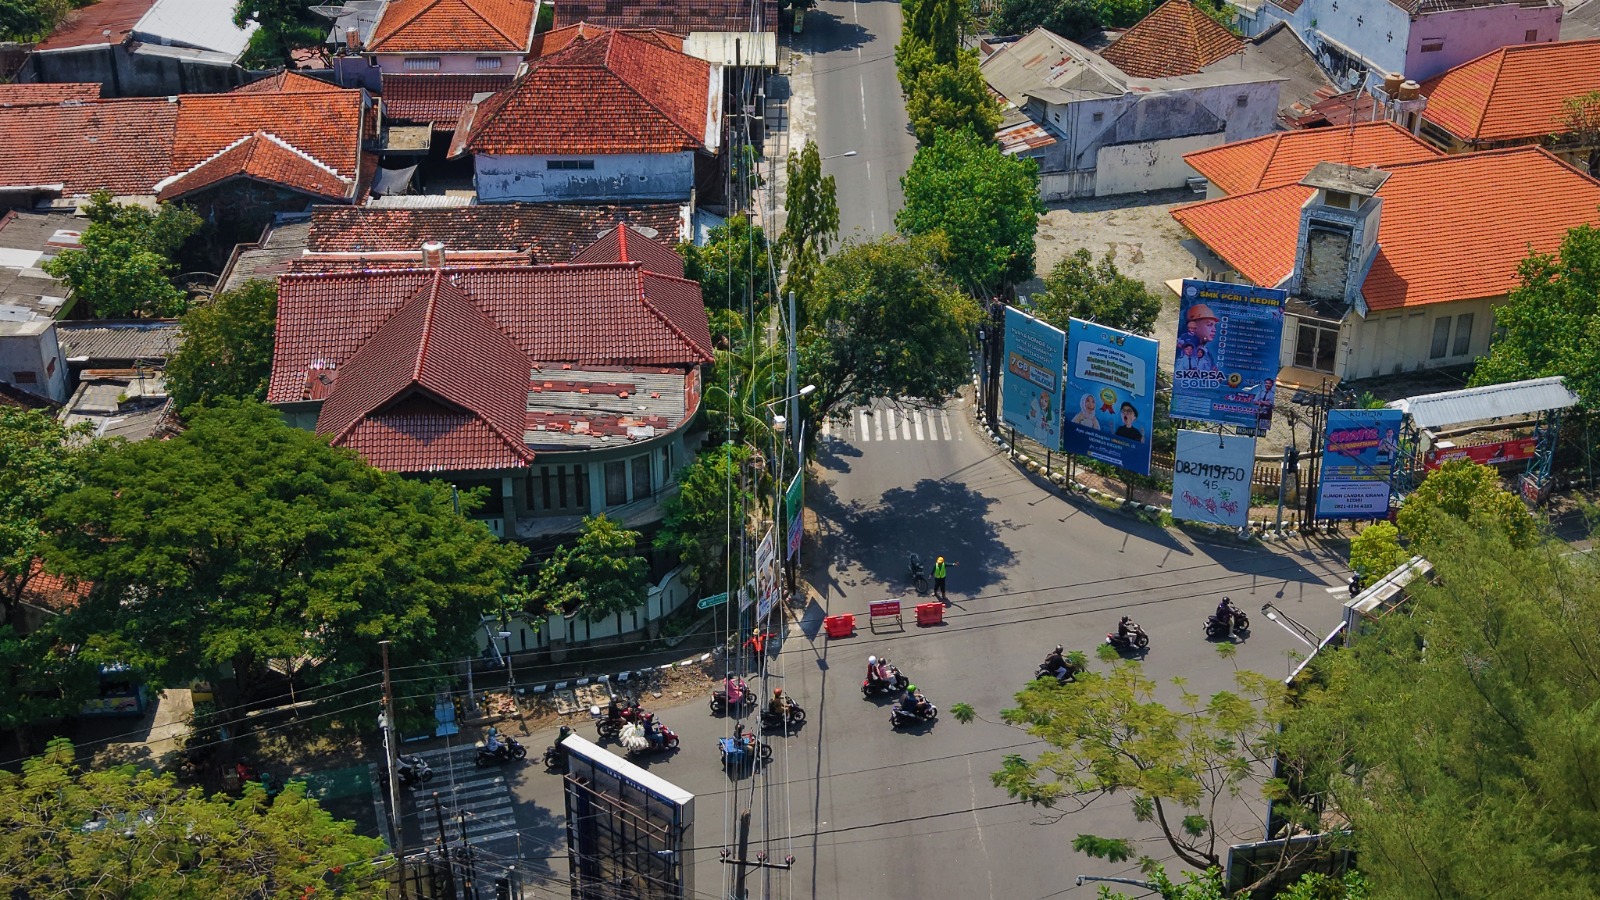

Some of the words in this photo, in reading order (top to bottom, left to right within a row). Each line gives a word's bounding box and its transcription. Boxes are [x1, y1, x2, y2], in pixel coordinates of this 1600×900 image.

[1199, 291, 1218, 299] SMK
[1221, 293, 1242, 302] PGRI
[1250, 297, 1280, 306] KEDIRI
[1016, 360, 1028, 372] GB
[1086, 356, 1107, 366] Sistem
[1107, 360, 1134, 374] Informasi
[1111, 368, 1129, 380] Kediri
[1175, 370, 1226, 381] SKAPSA
[1181, 379, 1220, 388] SOLID
[1329, 428, 1379, 443] GRATIS
[1203, 479, 1219, 491] 45
